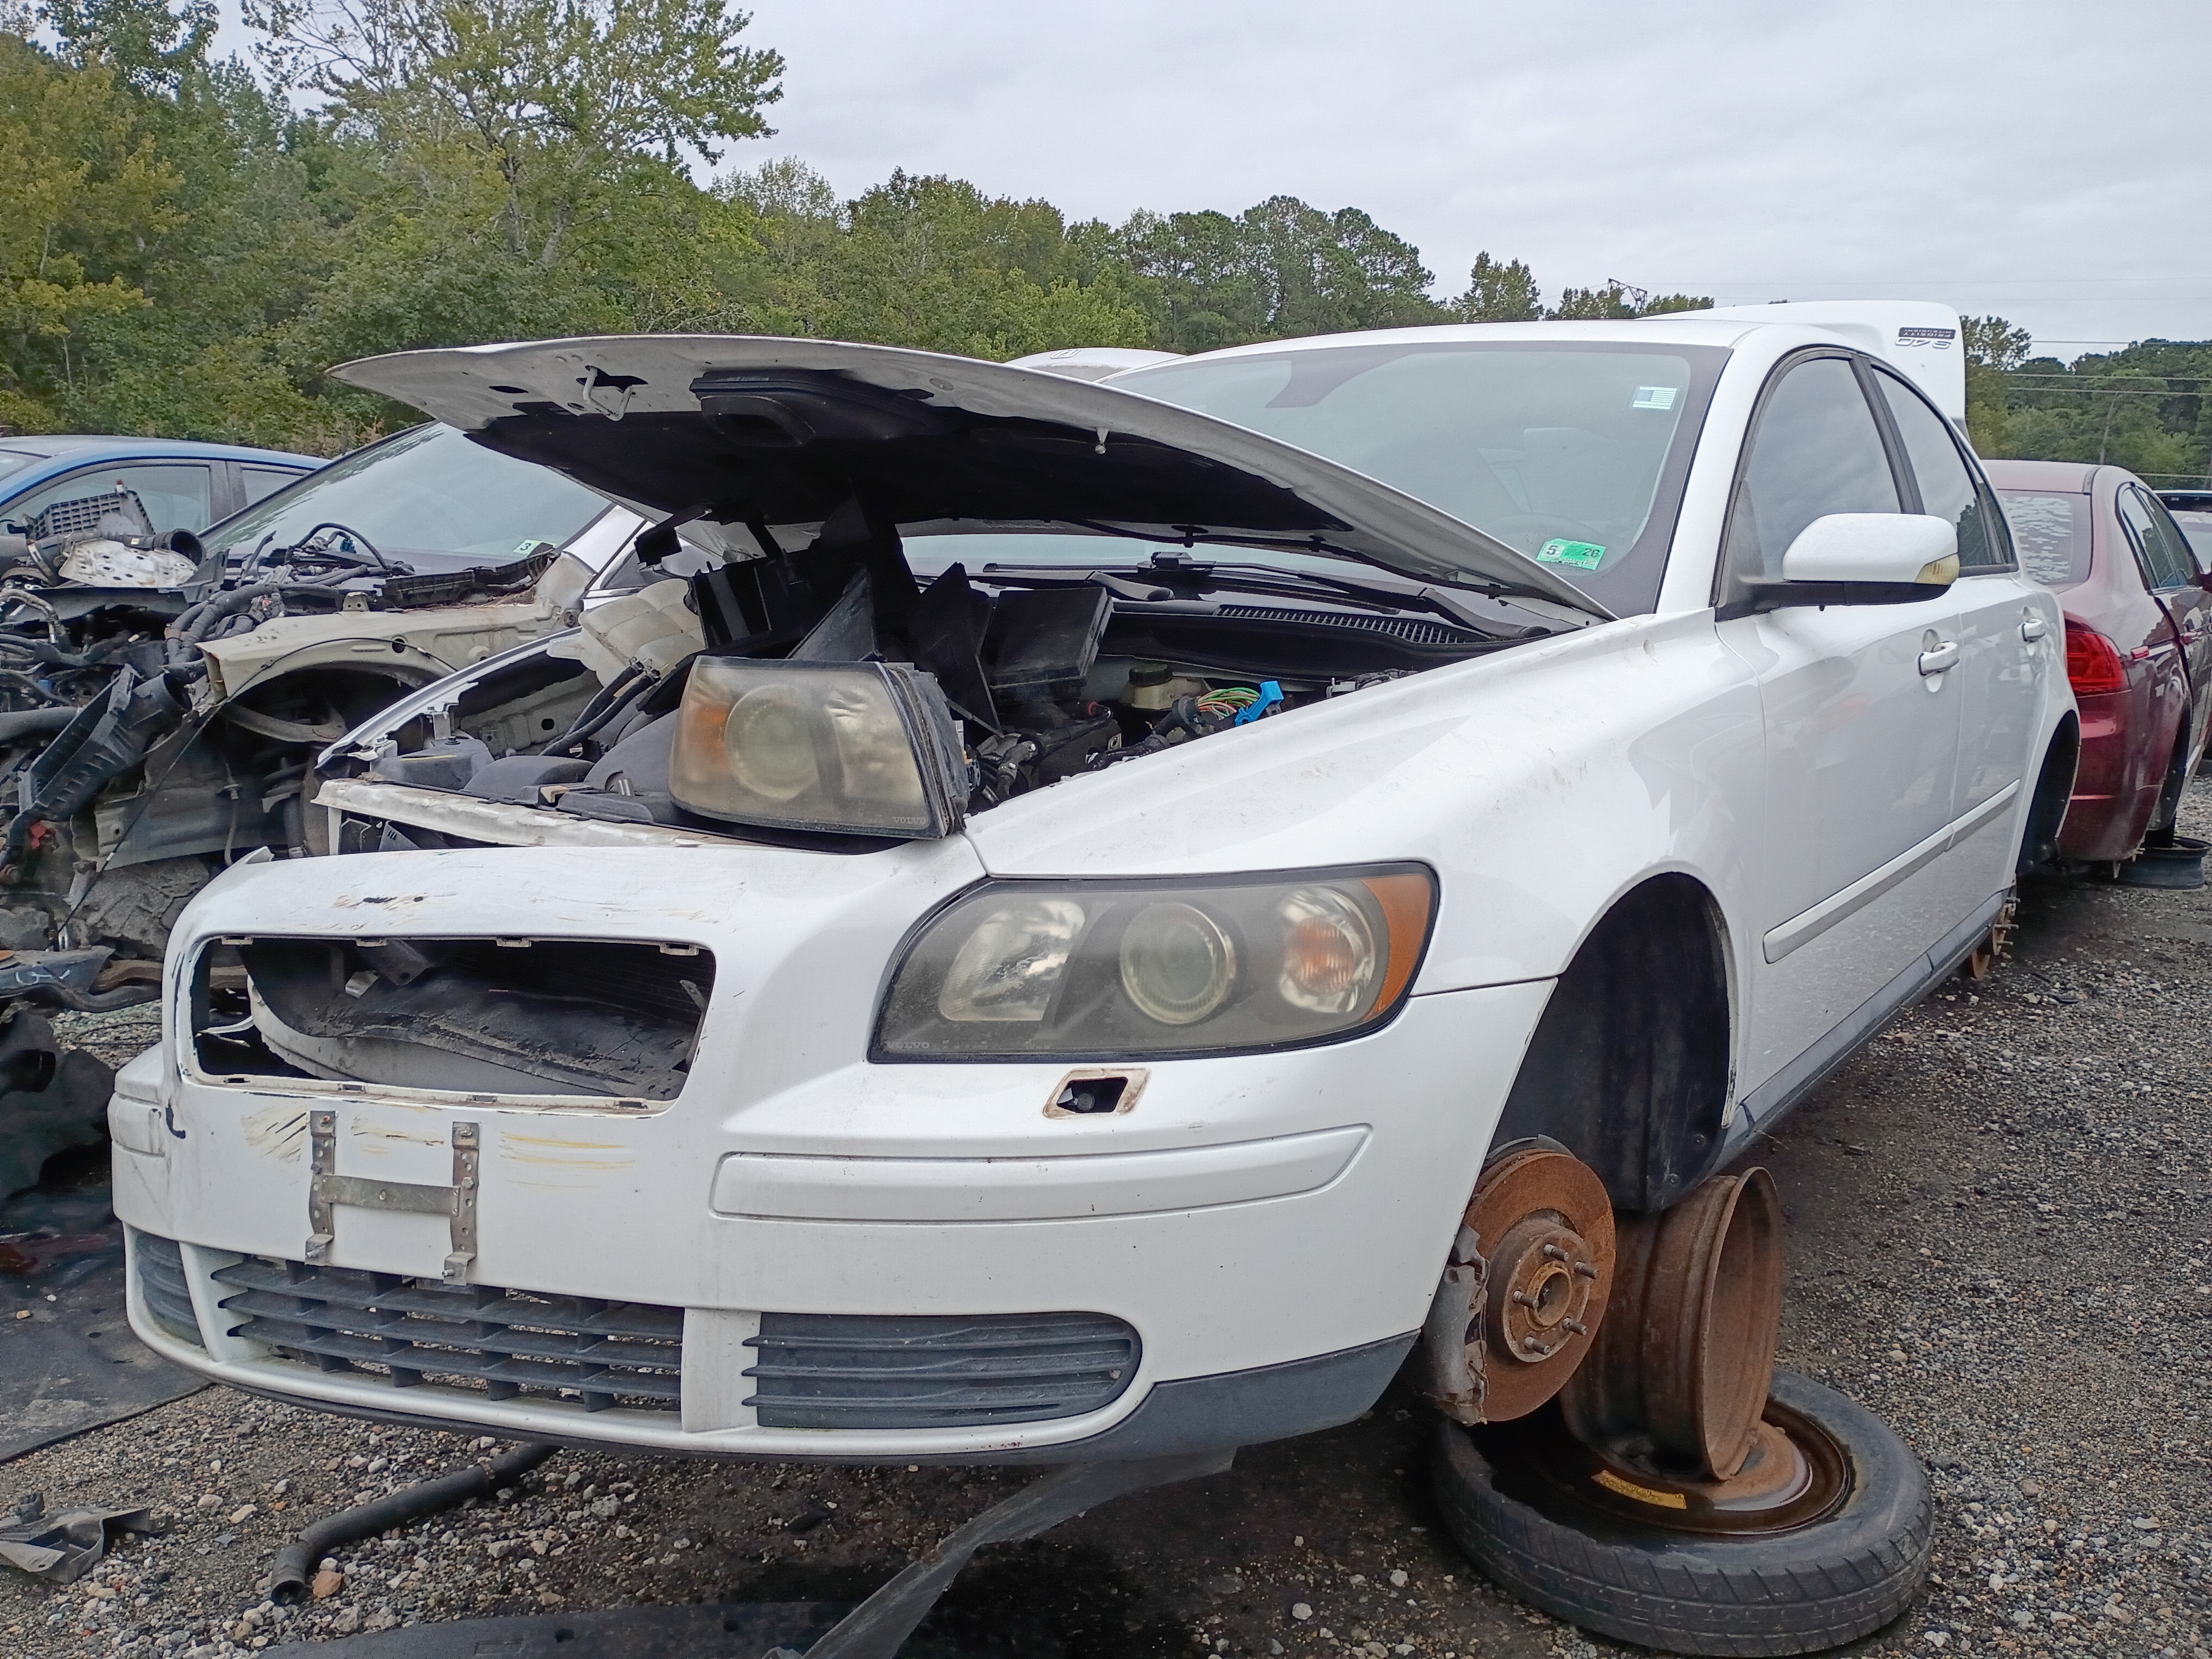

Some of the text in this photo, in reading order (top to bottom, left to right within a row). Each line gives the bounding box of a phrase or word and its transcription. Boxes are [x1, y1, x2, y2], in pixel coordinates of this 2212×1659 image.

[520, 543, 531, 551] 3
[1546, 545, 1558, 555] 5
[1582, 548, 1600, 558] 26
[892, 816, 927, 825] VOLVO
[886, 1040, 930, 1049] VOLVO
